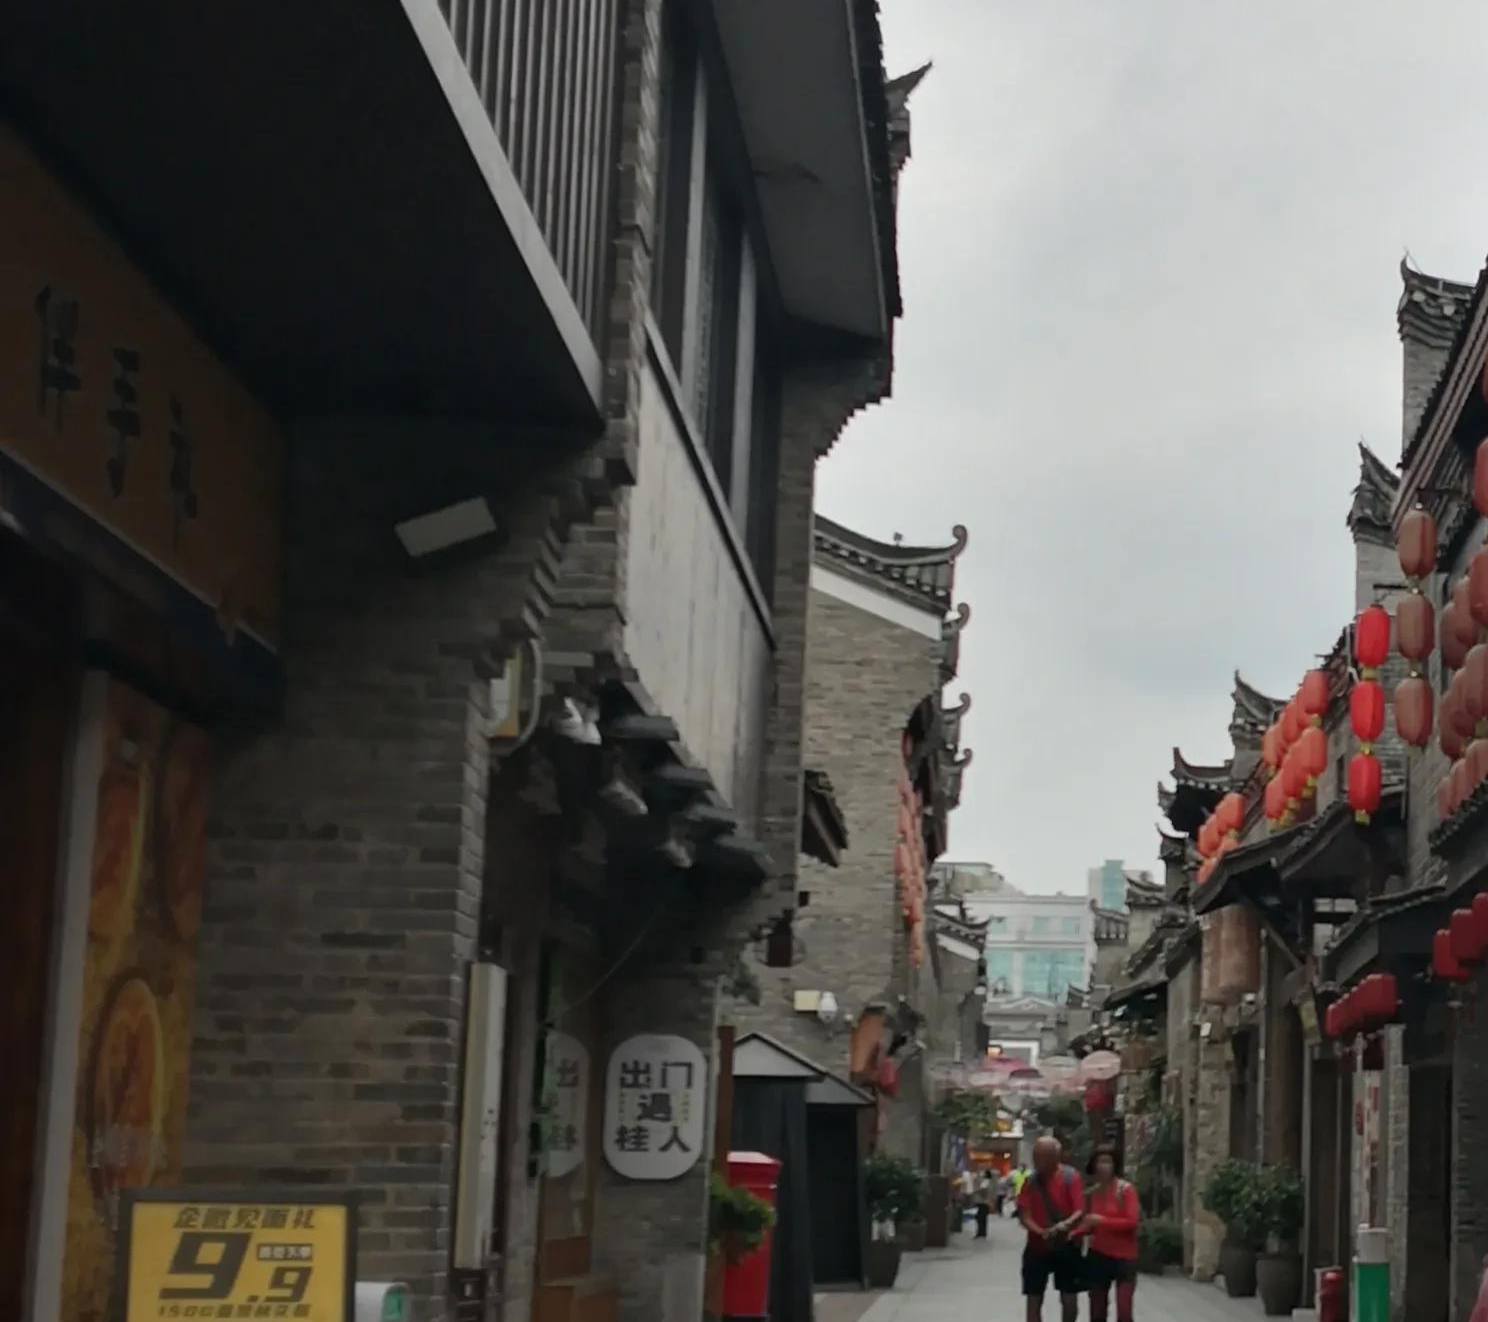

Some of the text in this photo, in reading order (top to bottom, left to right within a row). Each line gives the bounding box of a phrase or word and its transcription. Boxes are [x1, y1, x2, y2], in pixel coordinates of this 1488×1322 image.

[620, 1059, 693, 1089] 出门
[614, 1124, 691, 1152] 桂人
[159, 1232, 313, 1302] 9.9
